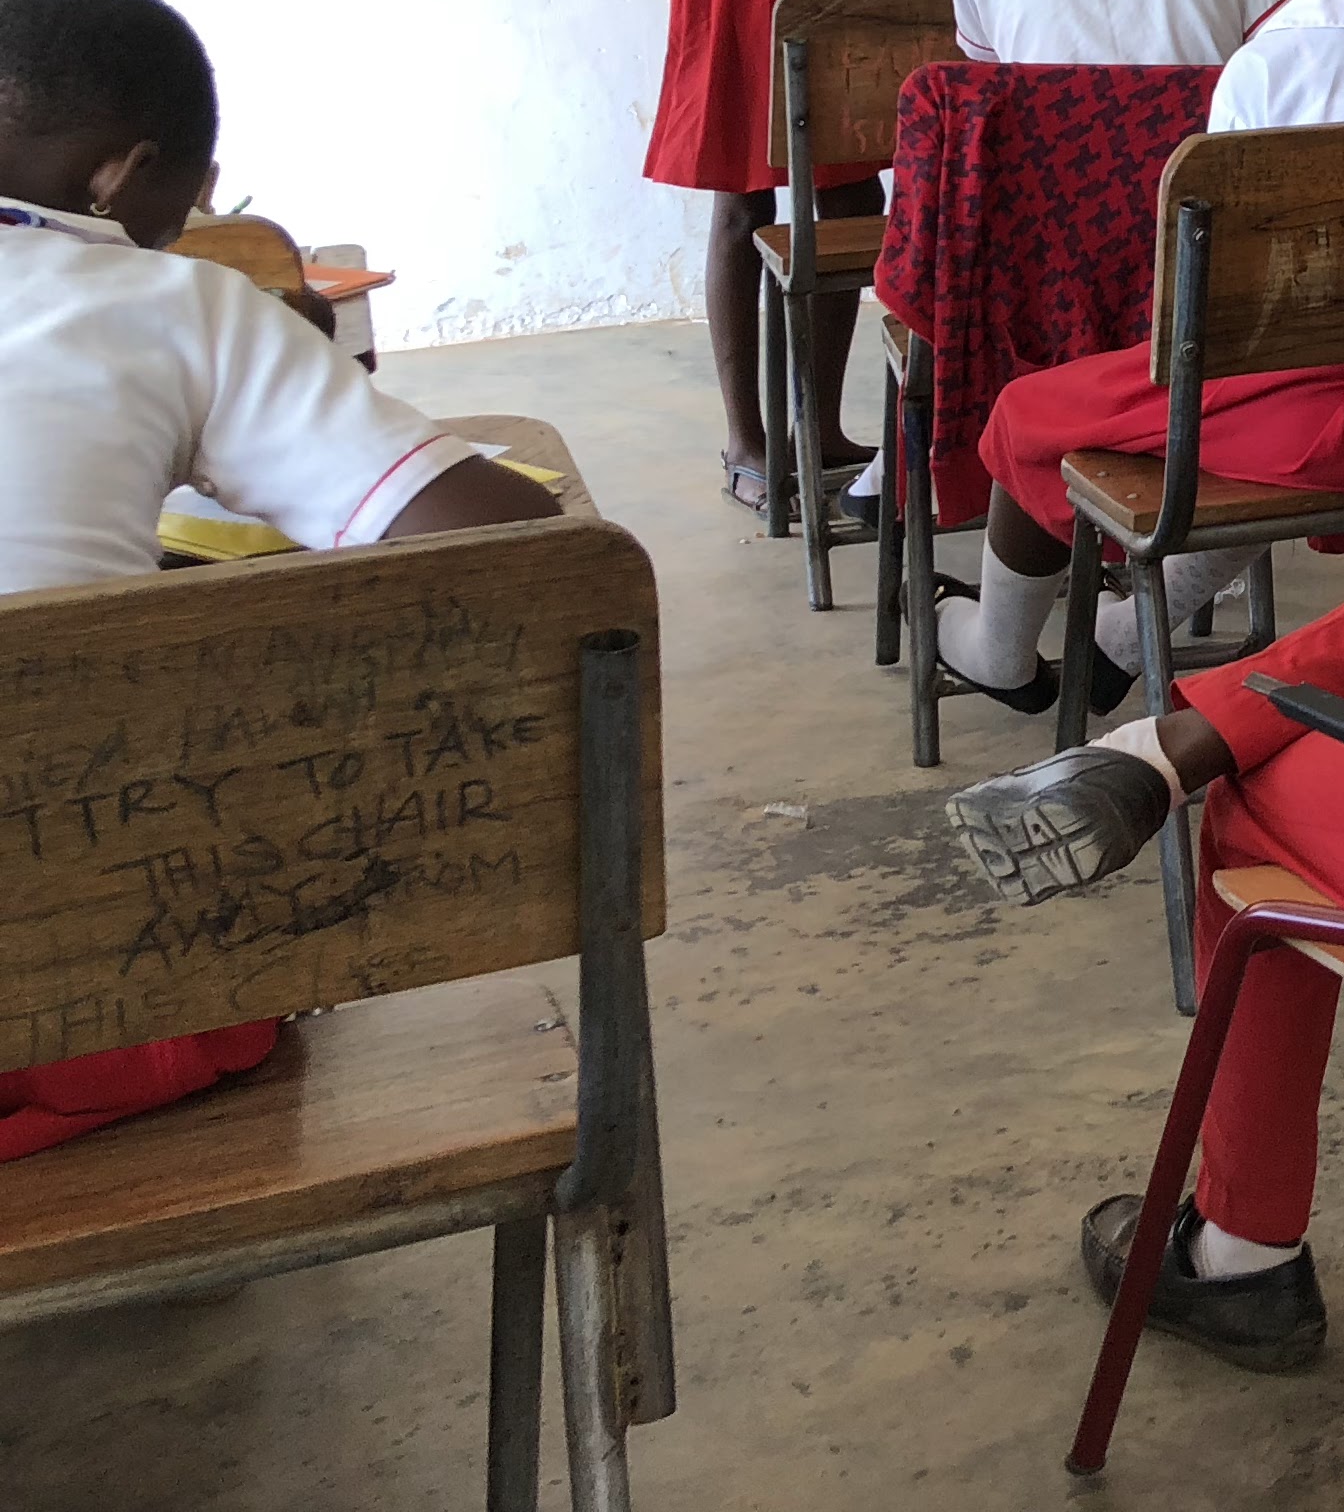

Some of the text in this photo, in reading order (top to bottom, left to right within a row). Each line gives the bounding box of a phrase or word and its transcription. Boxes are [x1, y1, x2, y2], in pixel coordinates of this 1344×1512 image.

[65, 765, 243, 847] TRY
[276, 749, 364, 798] TO
[385, 714, 547, 776] TAKE
[100, 778, 514, 900] THIS CHAIR
